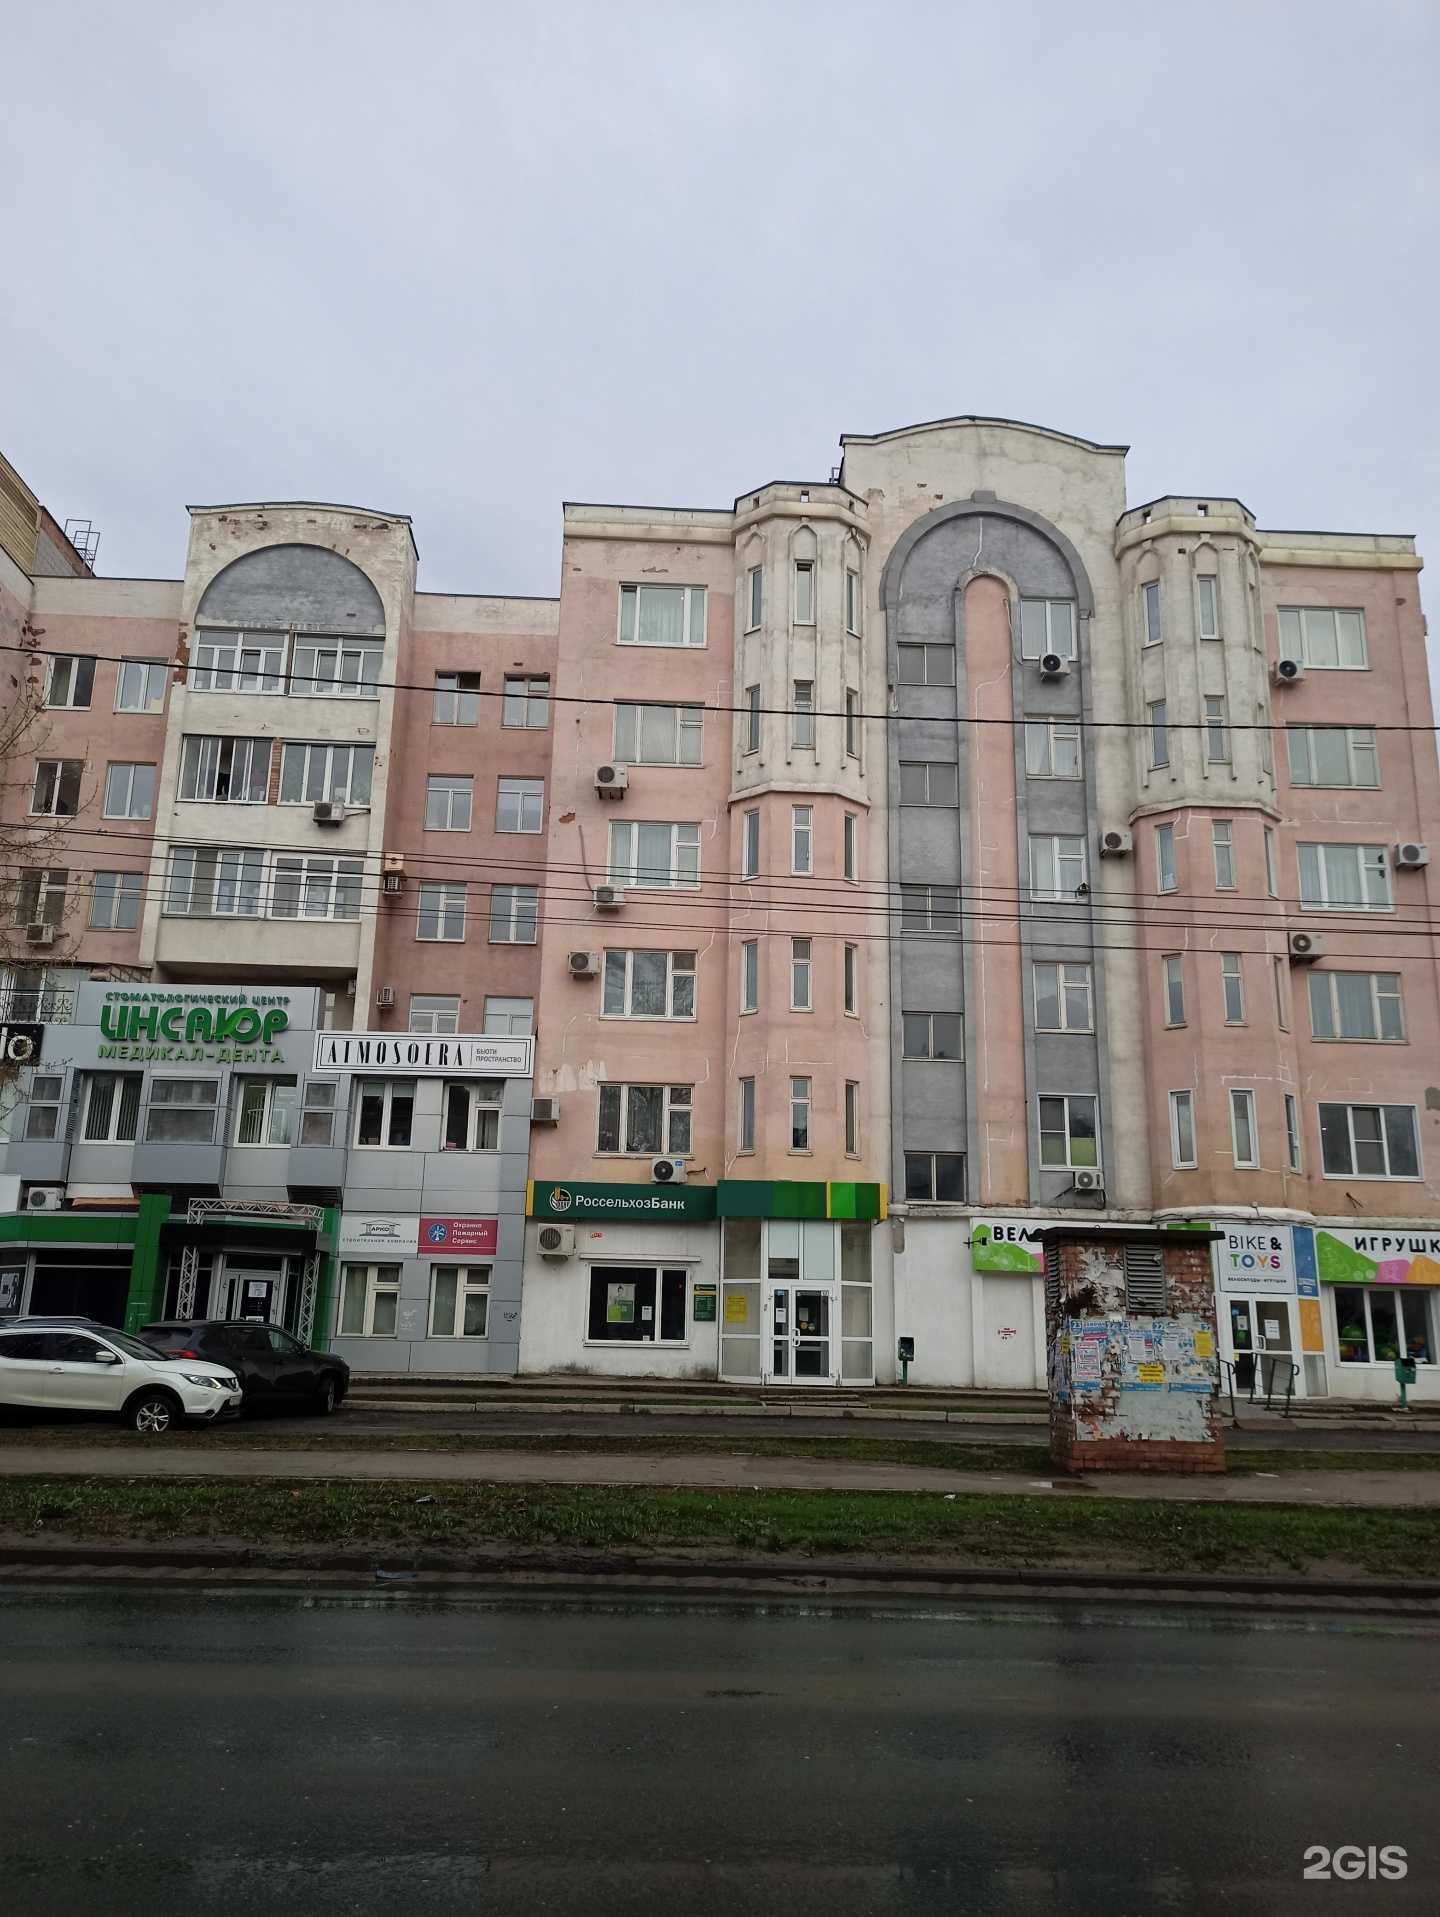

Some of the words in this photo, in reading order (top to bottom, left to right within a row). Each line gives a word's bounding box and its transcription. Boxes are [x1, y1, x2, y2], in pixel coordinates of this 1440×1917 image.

[105, 992, 248, 1006] СТОМАТОЛОГИЧЕСКИЙ
[252, 995, 290, 1006] ЦЕНТР
[98, 1045, 285, 1064] МЕДИКАЛ-ДЕНТА
[475, 1055, 522, 1063] ПРОСТРАНСТВО
[575, 1195, 686, 1210] РоссельхозБанк
[452, 1229, 488, 1237] Пожарный
[452, 1237, 479, 1245] Сервис
[1229, 1235, 1266, 1250] BIKE
[1270, 1237, 1282, 1250] &
[1230, 1253, 1281, 1269] TOYS
